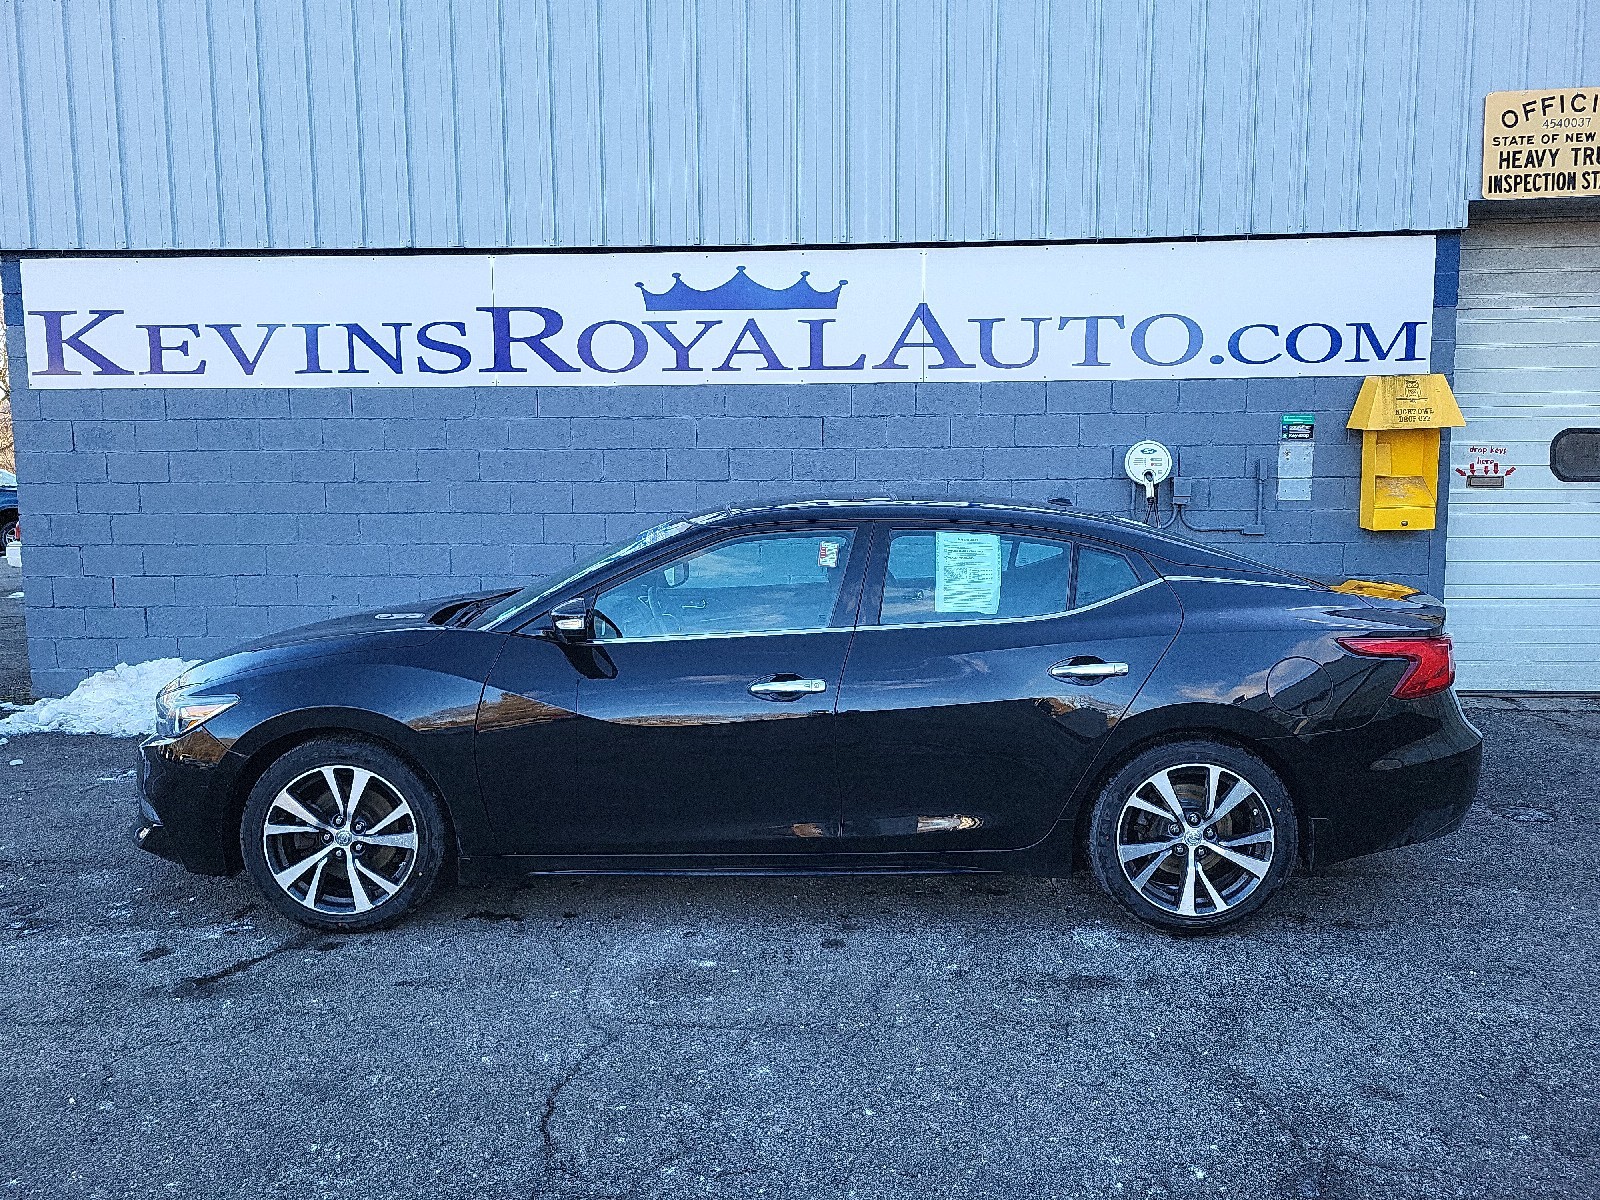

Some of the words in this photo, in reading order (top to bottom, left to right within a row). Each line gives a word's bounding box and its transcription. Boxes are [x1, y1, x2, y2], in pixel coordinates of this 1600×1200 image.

[1501, 94, 1599, 128] OFFICI
[1542, 117, 1592, 129] 4540037
[1492, 135, 1535, 147] STATE
[1541, 134, 1560, 144] OF
[1565, 132, 1596, 143] NEW
[1498, 148, 1561, 170] HEAVY
[1487, 172, 1577, 194] INSPECTION
[1581, 170, 1600, 190] ST
[1469, 445, 1488, 454] drop
[1490, 445, 1507, 454] keys
